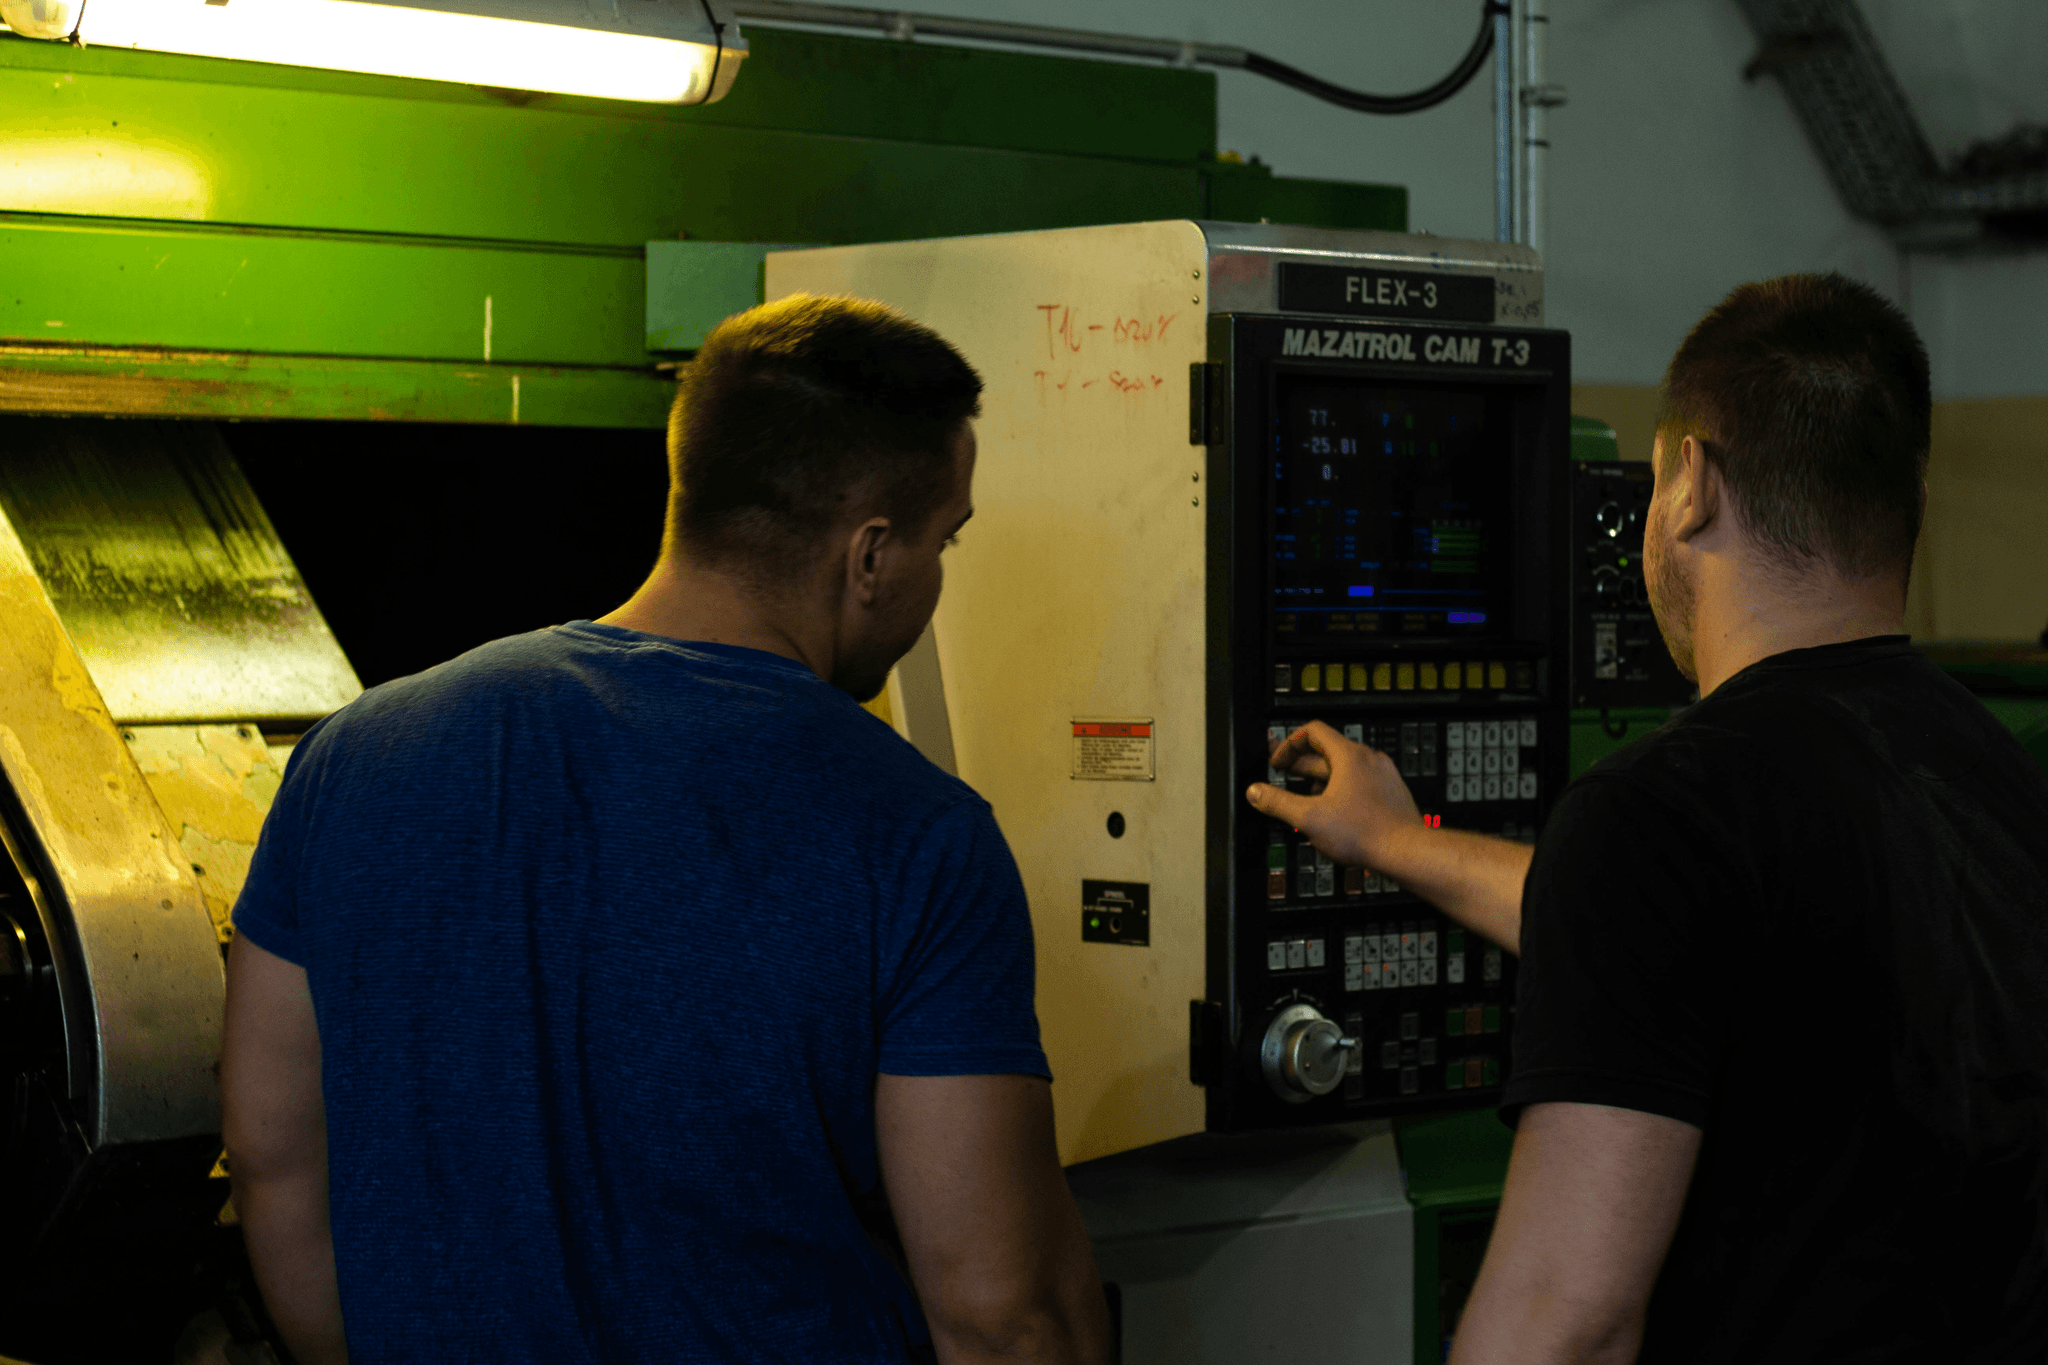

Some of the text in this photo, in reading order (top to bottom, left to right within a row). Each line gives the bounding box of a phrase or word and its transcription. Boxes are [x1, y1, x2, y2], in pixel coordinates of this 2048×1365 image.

[1345, 275, 1438, 309] FLEX-3
[1282, 327, 1530, 367] MAZATROL CAM T-3
